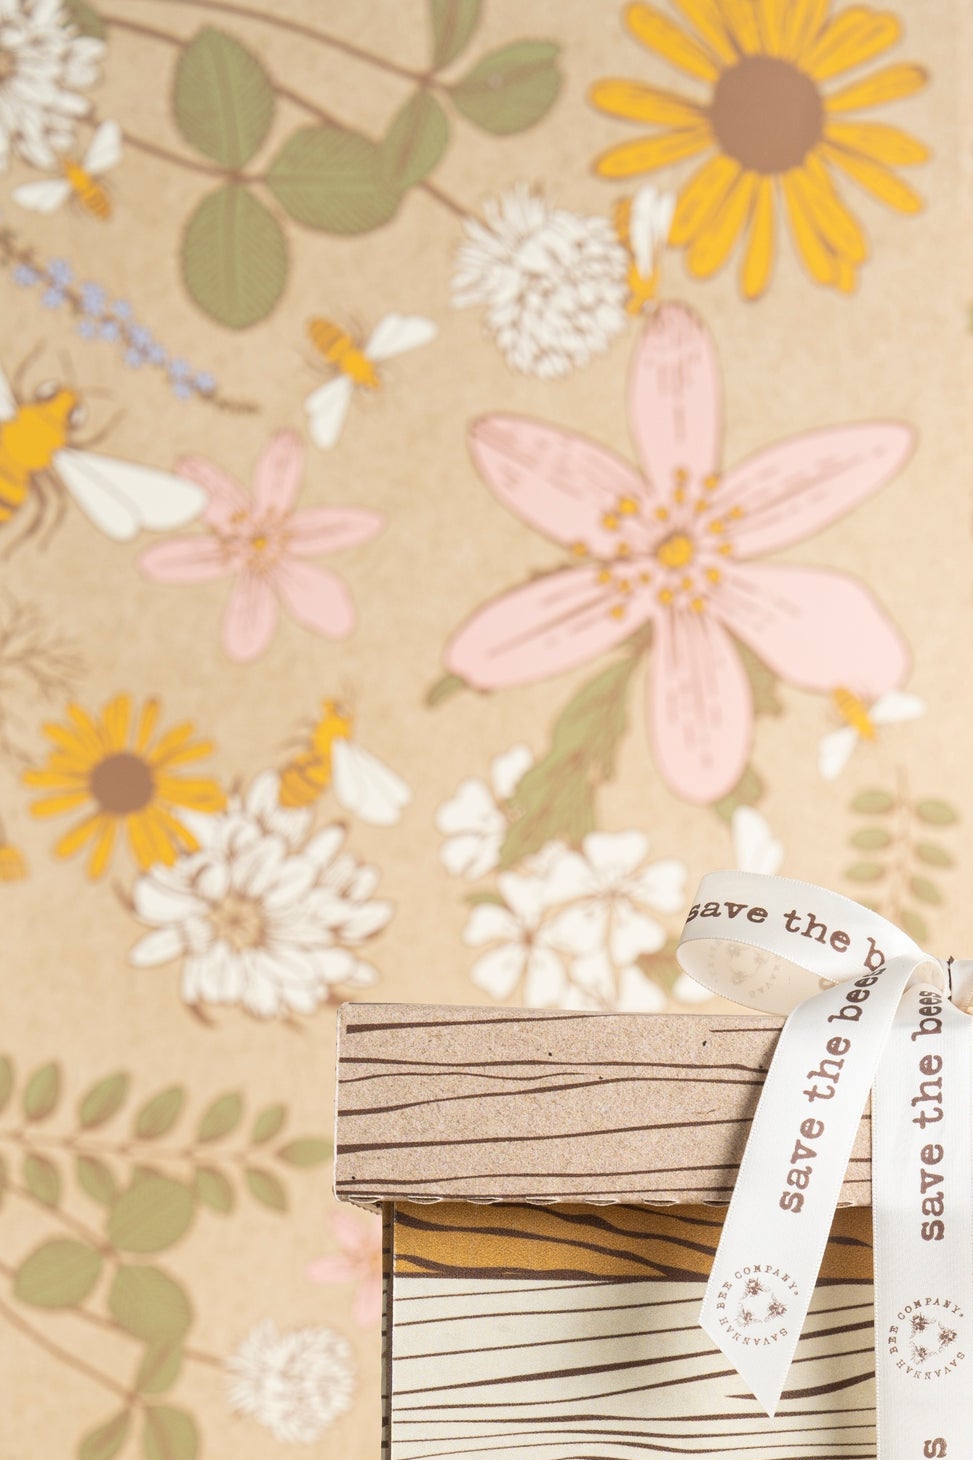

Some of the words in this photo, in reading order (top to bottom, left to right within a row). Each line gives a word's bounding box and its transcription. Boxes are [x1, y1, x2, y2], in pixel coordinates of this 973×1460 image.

[686, 902, 768, 924] save
[784, 910, 850, 952] the
[911, 990, 942, 1042] bees
[911, 1055, 943, 1129] the
[780, 1119, 824, 1213] save
[804, 1037, 850, 1102] the
[921, 1144, 944, 1241] save
[716, 1281, 732, 1310] BEE
[718, 1316, 788, 1347] SAVANNAH
[888, 1325, 899, 1355] BEE
[895, 1350, 965, 1380] SAVANNAH
